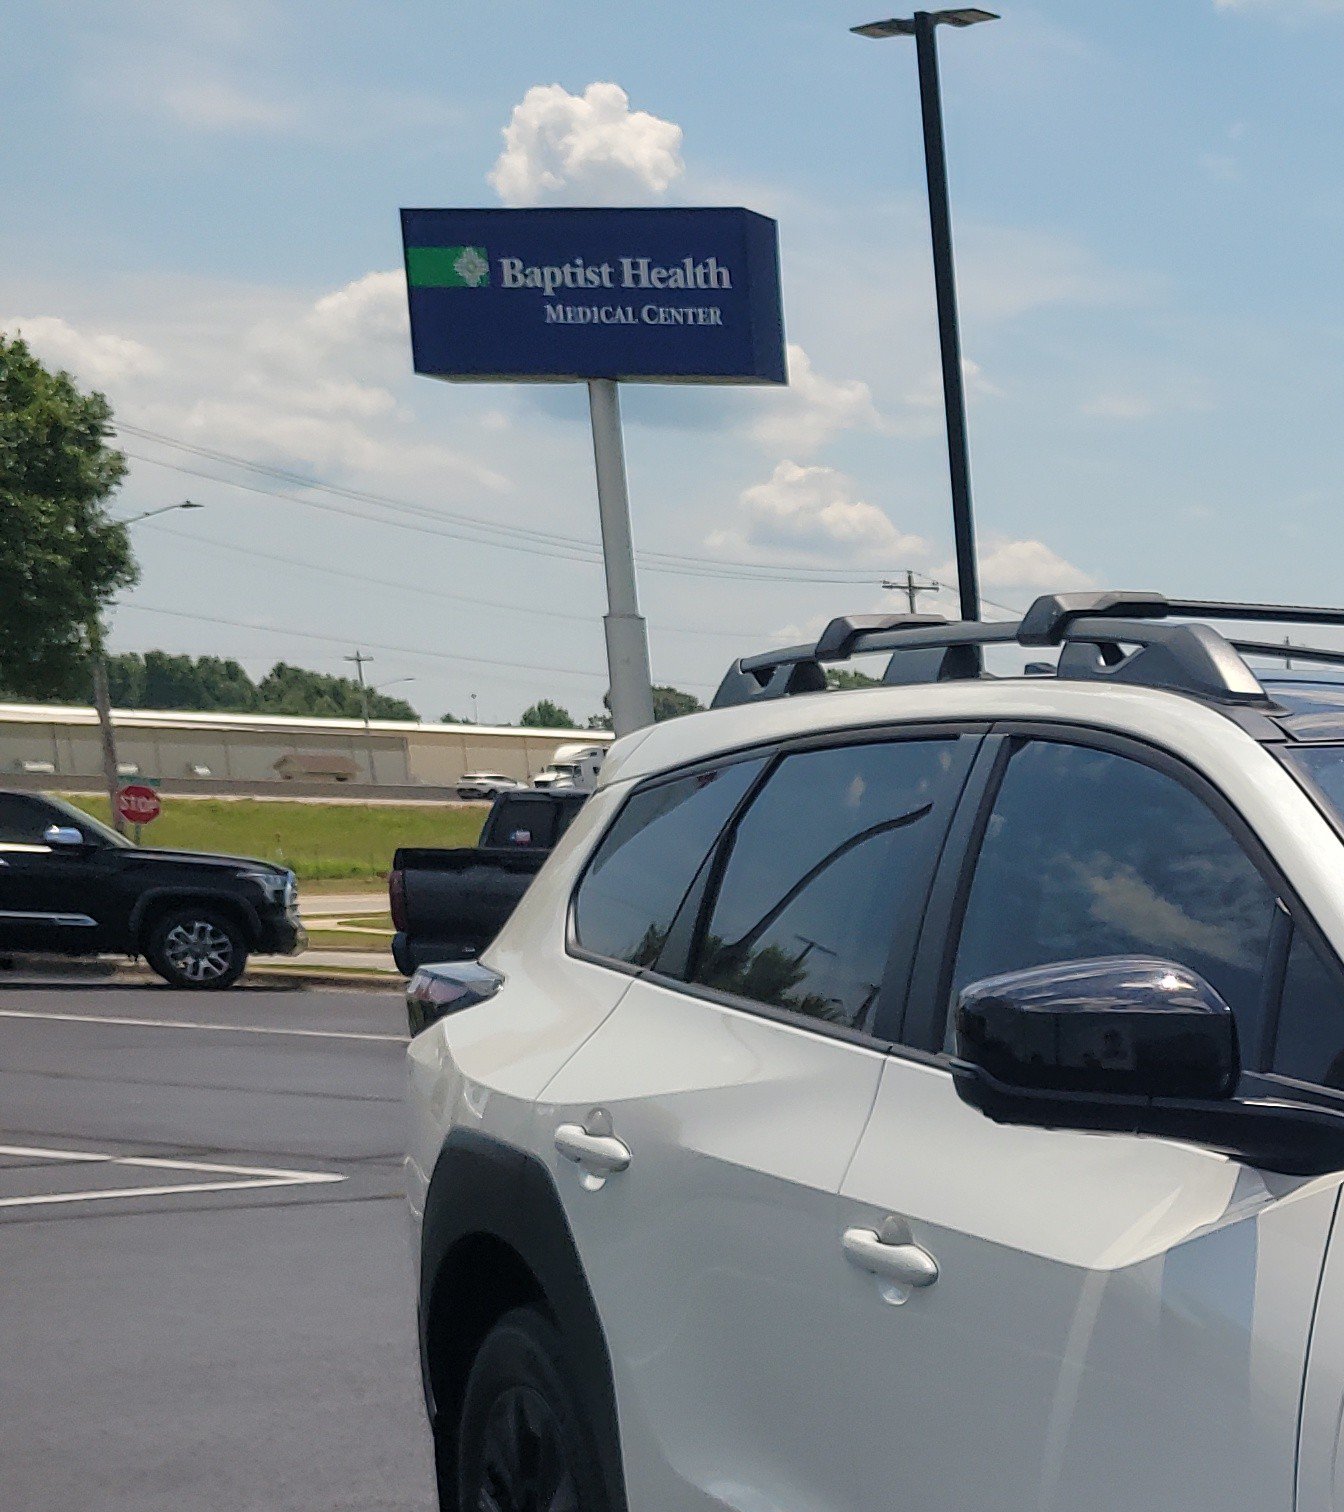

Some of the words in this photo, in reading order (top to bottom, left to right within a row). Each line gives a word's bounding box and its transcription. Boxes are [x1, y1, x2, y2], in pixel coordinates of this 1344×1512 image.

[499, 256, 614, 297] Baptist
[616, 256, 733, 290] Health
[544, 303, 639, 325] MEDICAL
[640, 304, 723, 326] CENTER
[120, 796, 158, 812] STOP
